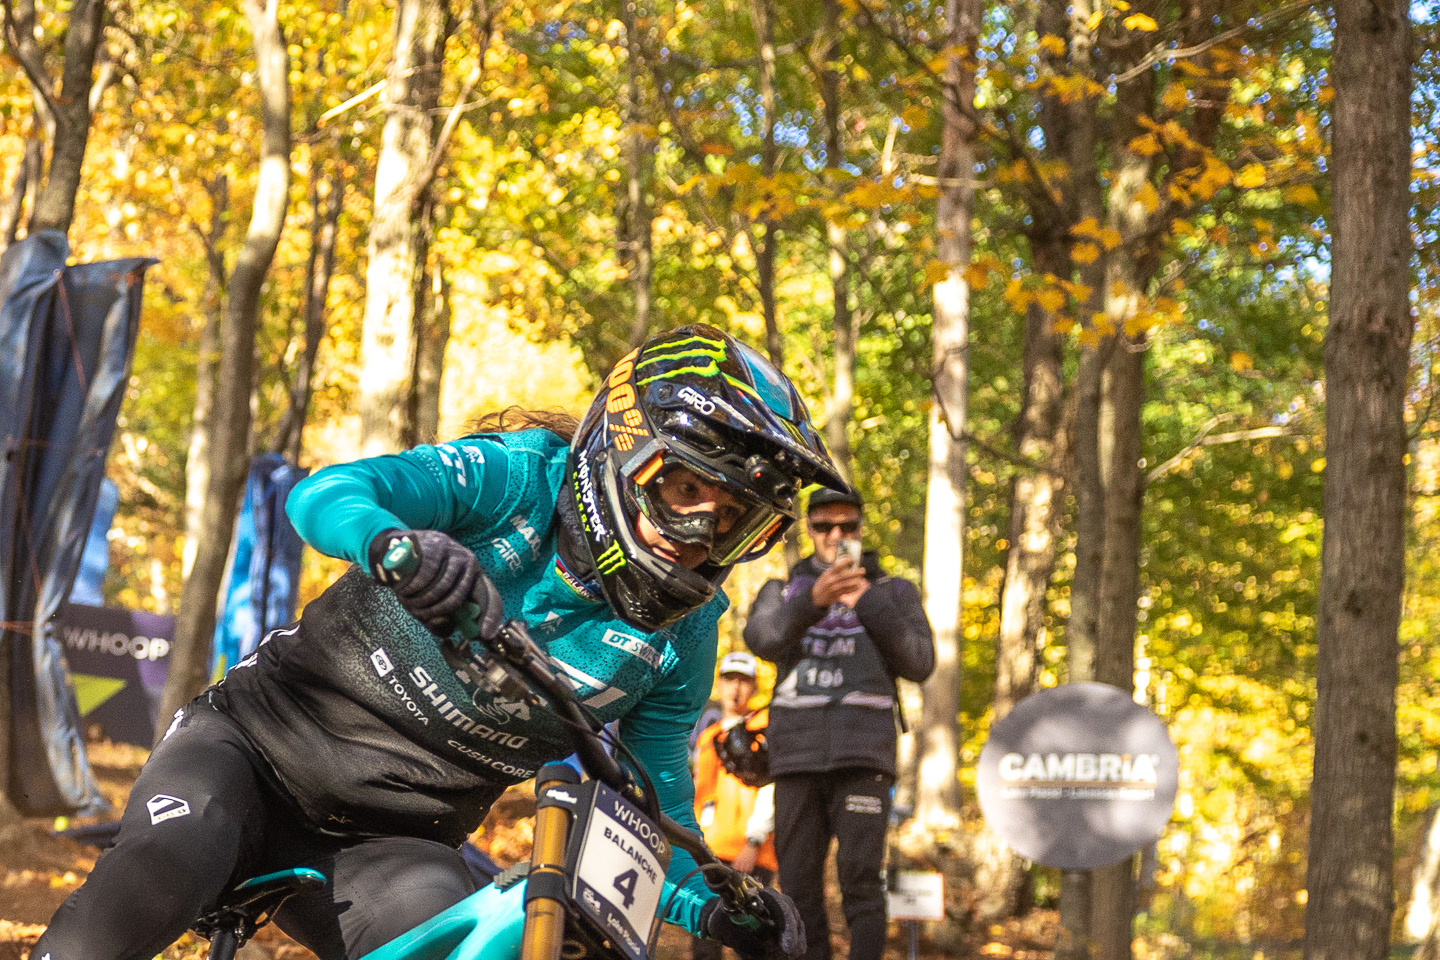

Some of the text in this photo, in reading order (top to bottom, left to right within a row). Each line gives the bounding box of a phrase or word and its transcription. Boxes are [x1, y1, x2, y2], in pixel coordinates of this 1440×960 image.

[606, 347, 650, 451] 100%
[677, 386, 716, 415] GIRO
[573, 471, 591, 532] ENERGY
[63, 627, 169, 662] WHOOP
[610, 634, 632, 647] DT
[388, 675, 429, 726] TOYOTA
[409, 666, 529, 749] SHIMANO
[614, 800, 666, 854] WHOOP
[604, 826, 658, 885] BALANCHE
[612, 867, 640, 910] 4
